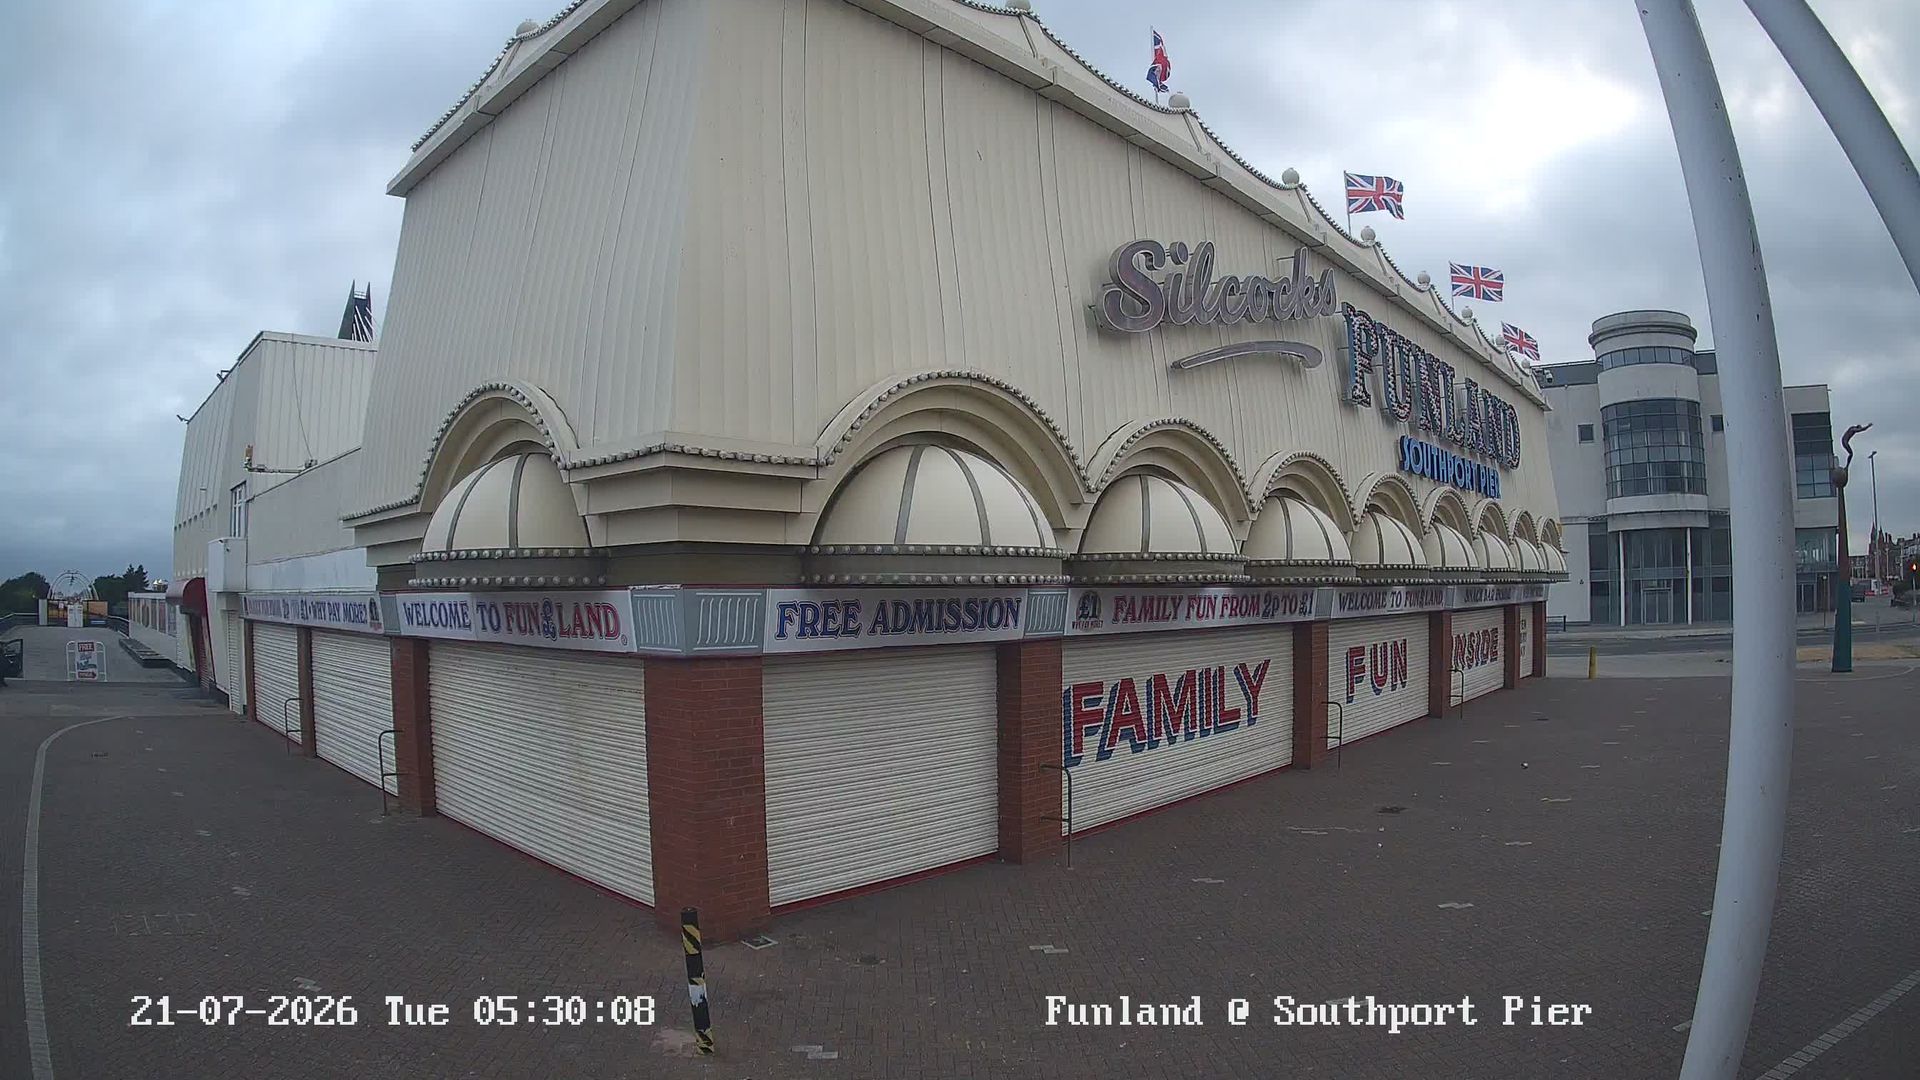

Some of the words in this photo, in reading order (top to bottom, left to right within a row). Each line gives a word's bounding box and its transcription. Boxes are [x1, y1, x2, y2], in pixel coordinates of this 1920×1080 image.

[1102, 239, 1337, 333] Silcocks
[1341, 301, 1521, 470] FUNLAND
[1400, 435, 1477, 492] SOUTHPORT
[1477, 464, 1502, 500] PIER
[328, 603, 341, 622] PAY
[403, 602, 472, 632] WELCOME
[477, 602, 501, 633] TO
[775, 600, 863, 641] FREE
[867, 598, 1022, 636] ADMISSION
[1112, 596, 1183, 625] FAMILY
[1185, 594, 1218, 621] FUN
[1219, 593, 1261, 618] FROM
[1281, 593, 1299, 615] TO
[1338, 591, 1388, 613] WELCOME
[1391, 590, 1403, 609] TO
[1346, 638, 1407, 704] FUN
[1063, 659, 1271, 767] FAMILY
